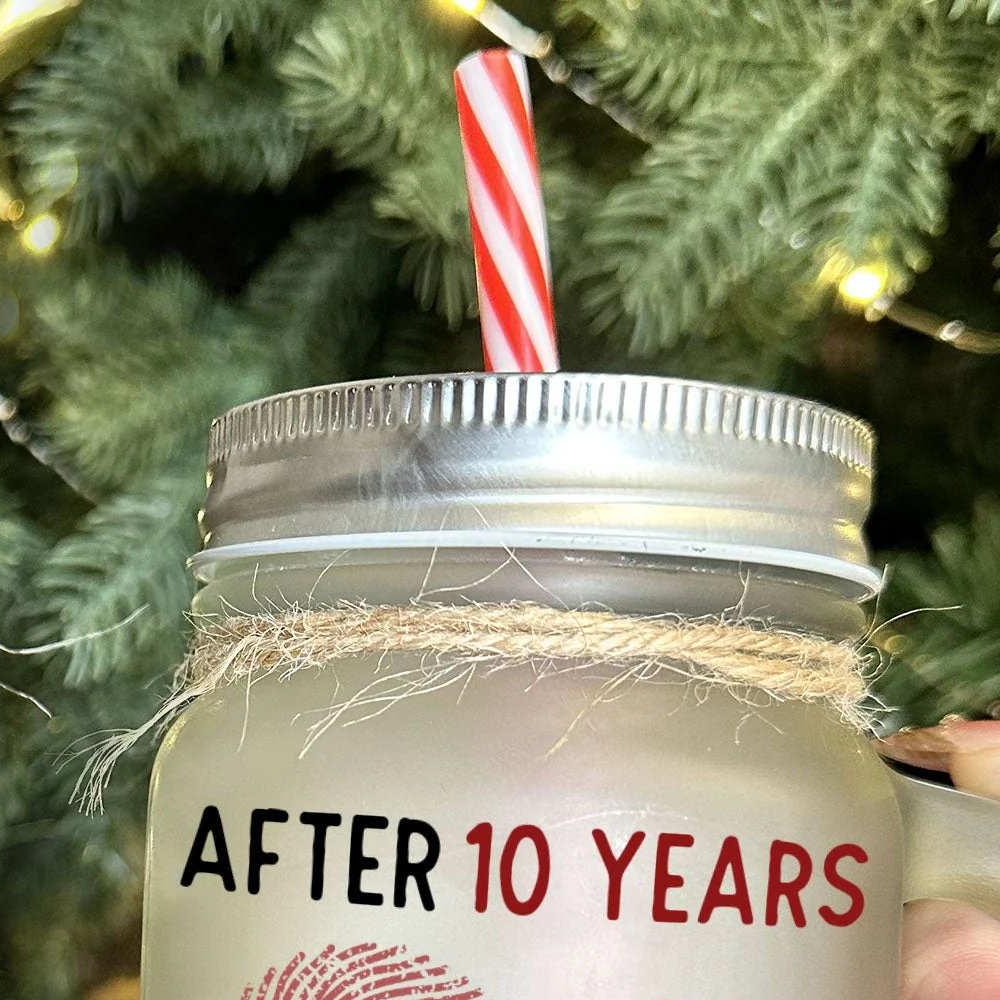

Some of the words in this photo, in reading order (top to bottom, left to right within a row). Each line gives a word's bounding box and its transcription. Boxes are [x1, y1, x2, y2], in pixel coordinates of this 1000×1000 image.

[181, 806, 440, 911] AFTER
[467, 822, 551, 917] 10
[592, 828, 869, 929] YEARS
